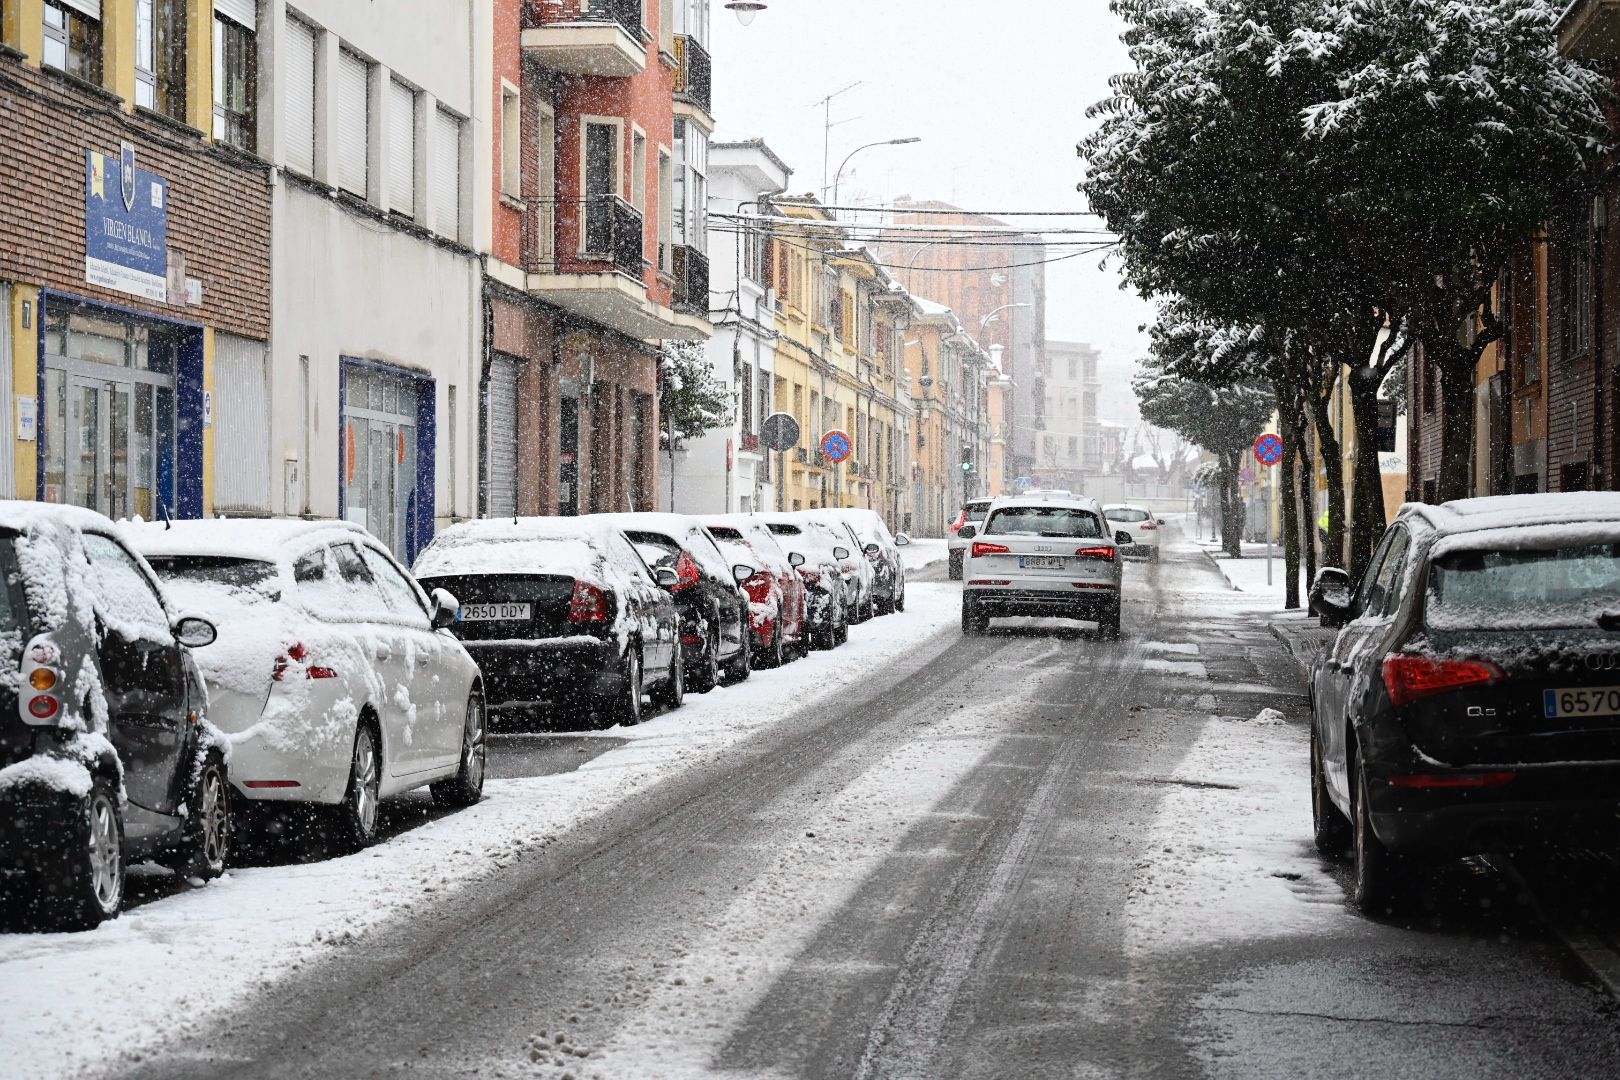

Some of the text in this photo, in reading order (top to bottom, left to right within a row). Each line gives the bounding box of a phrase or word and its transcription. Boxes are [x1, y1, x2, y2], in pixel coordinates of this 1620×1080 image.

[102, 216, 127, 241] VIRGEN
[127, 224, 152, 249] BLANCA
[464, 605, 525, 619] 2650 DDY
[1561, 691, 1620, 713] 6570
[1467, 706, 1496, 717] Q5
